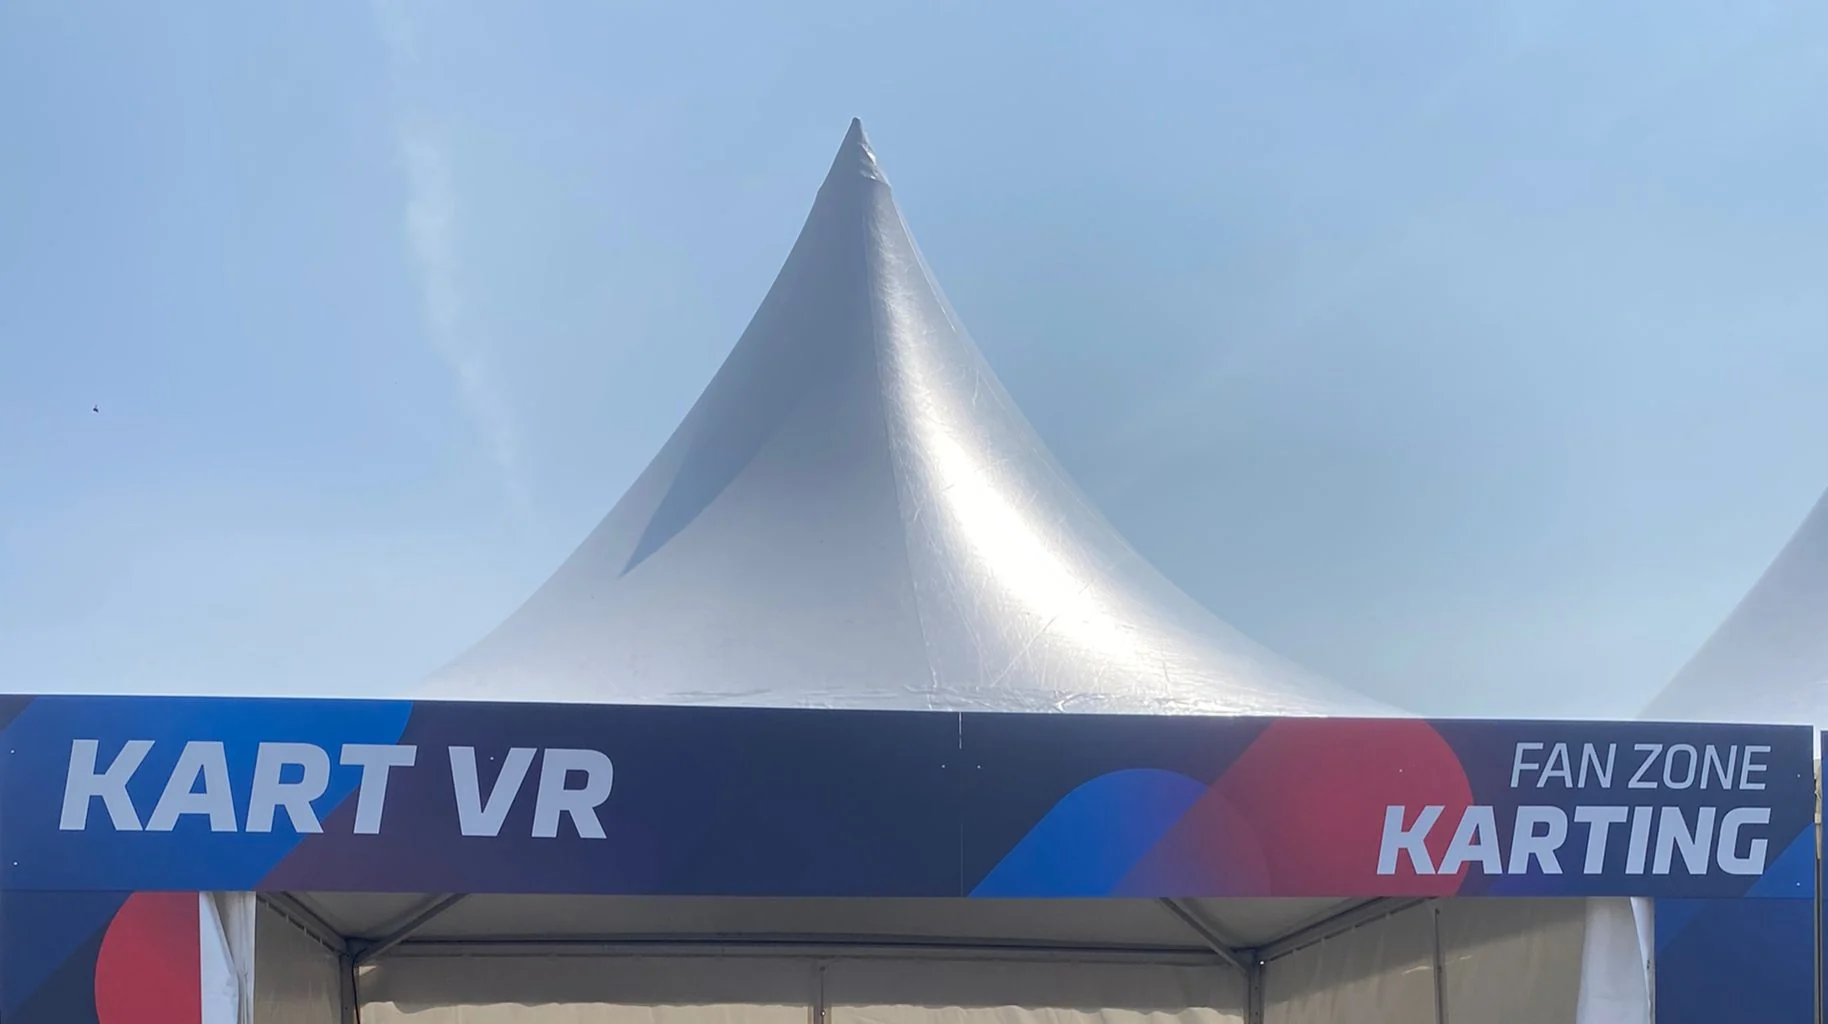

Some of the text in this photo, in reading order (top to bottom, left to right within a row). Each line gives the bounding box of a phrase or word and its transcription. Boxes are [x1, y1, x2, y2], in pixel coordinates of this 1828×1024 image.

[59, 739, 614, 839] KART VR
[1510, 742, 1771, 790] FAN ZONE
[1376, 805, 1771, 875] KARTING
